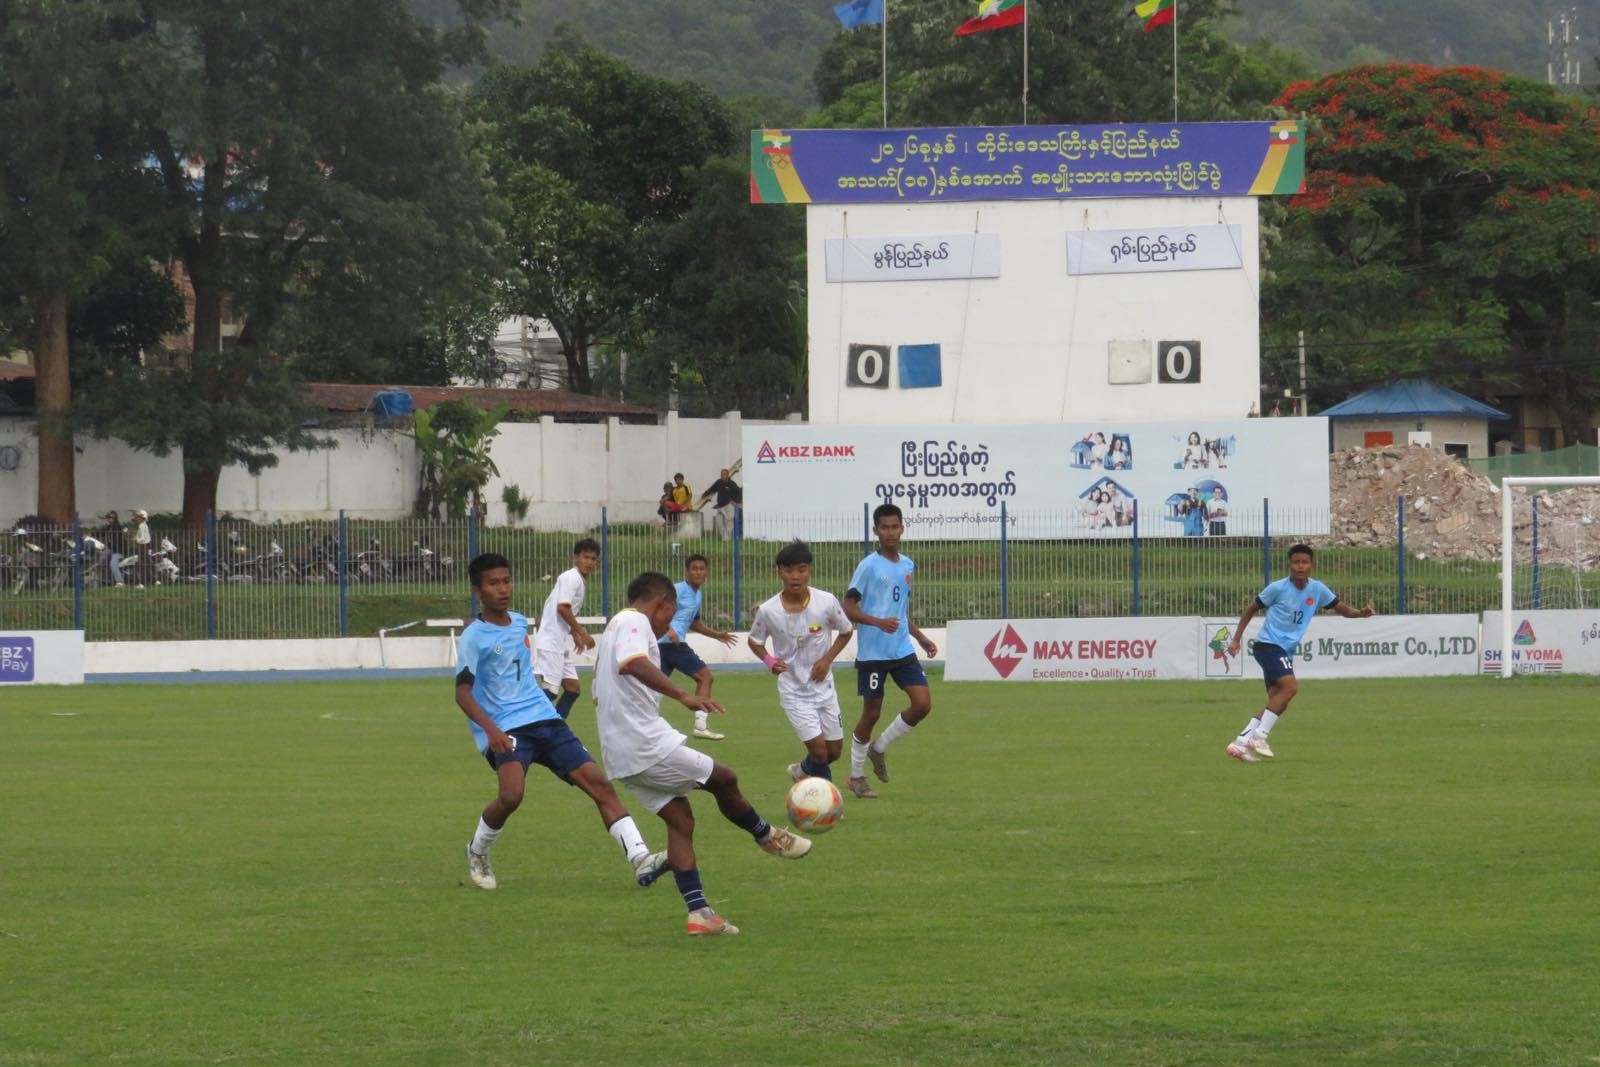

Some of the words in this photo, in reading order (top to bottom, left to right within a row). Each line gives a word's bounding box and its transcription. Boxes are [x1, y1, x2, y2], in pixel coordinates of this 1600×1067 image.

[873, 242, 950, 269] မွန်ပြည်နယ်
[1110, 233, 1197, 263] ရှမ်းပြည်နယ်
[857, 350, 883, 384] 0
[1166, 345, 1193, 380] 0
[779, 446, 809, 457] KBZ
[813, 446, 855, 457] BANK
[892, 585, 900, 603] 6
[1292, 611, 1303, 624] 12
[0, 647, 23, 659] BZ
[1033, 640, 1073, 660] MAX
[1078, 639, 1157, 659] ENERGY
[1318, 638, 1399, 661] Myanmar
[1484, 649, 1520, 661] SHN
[1525, 649, 1563, 661] YOMA
[2, 659, 29, 673] Pay
[512, 659, 521, 681] 7
[1033, 668, 1083, 679] Excellence
[1090, 668, 1124, 679] Quality
[1132, 667, 1156, 678] Trust
[869, 672, 879, 690] 6
